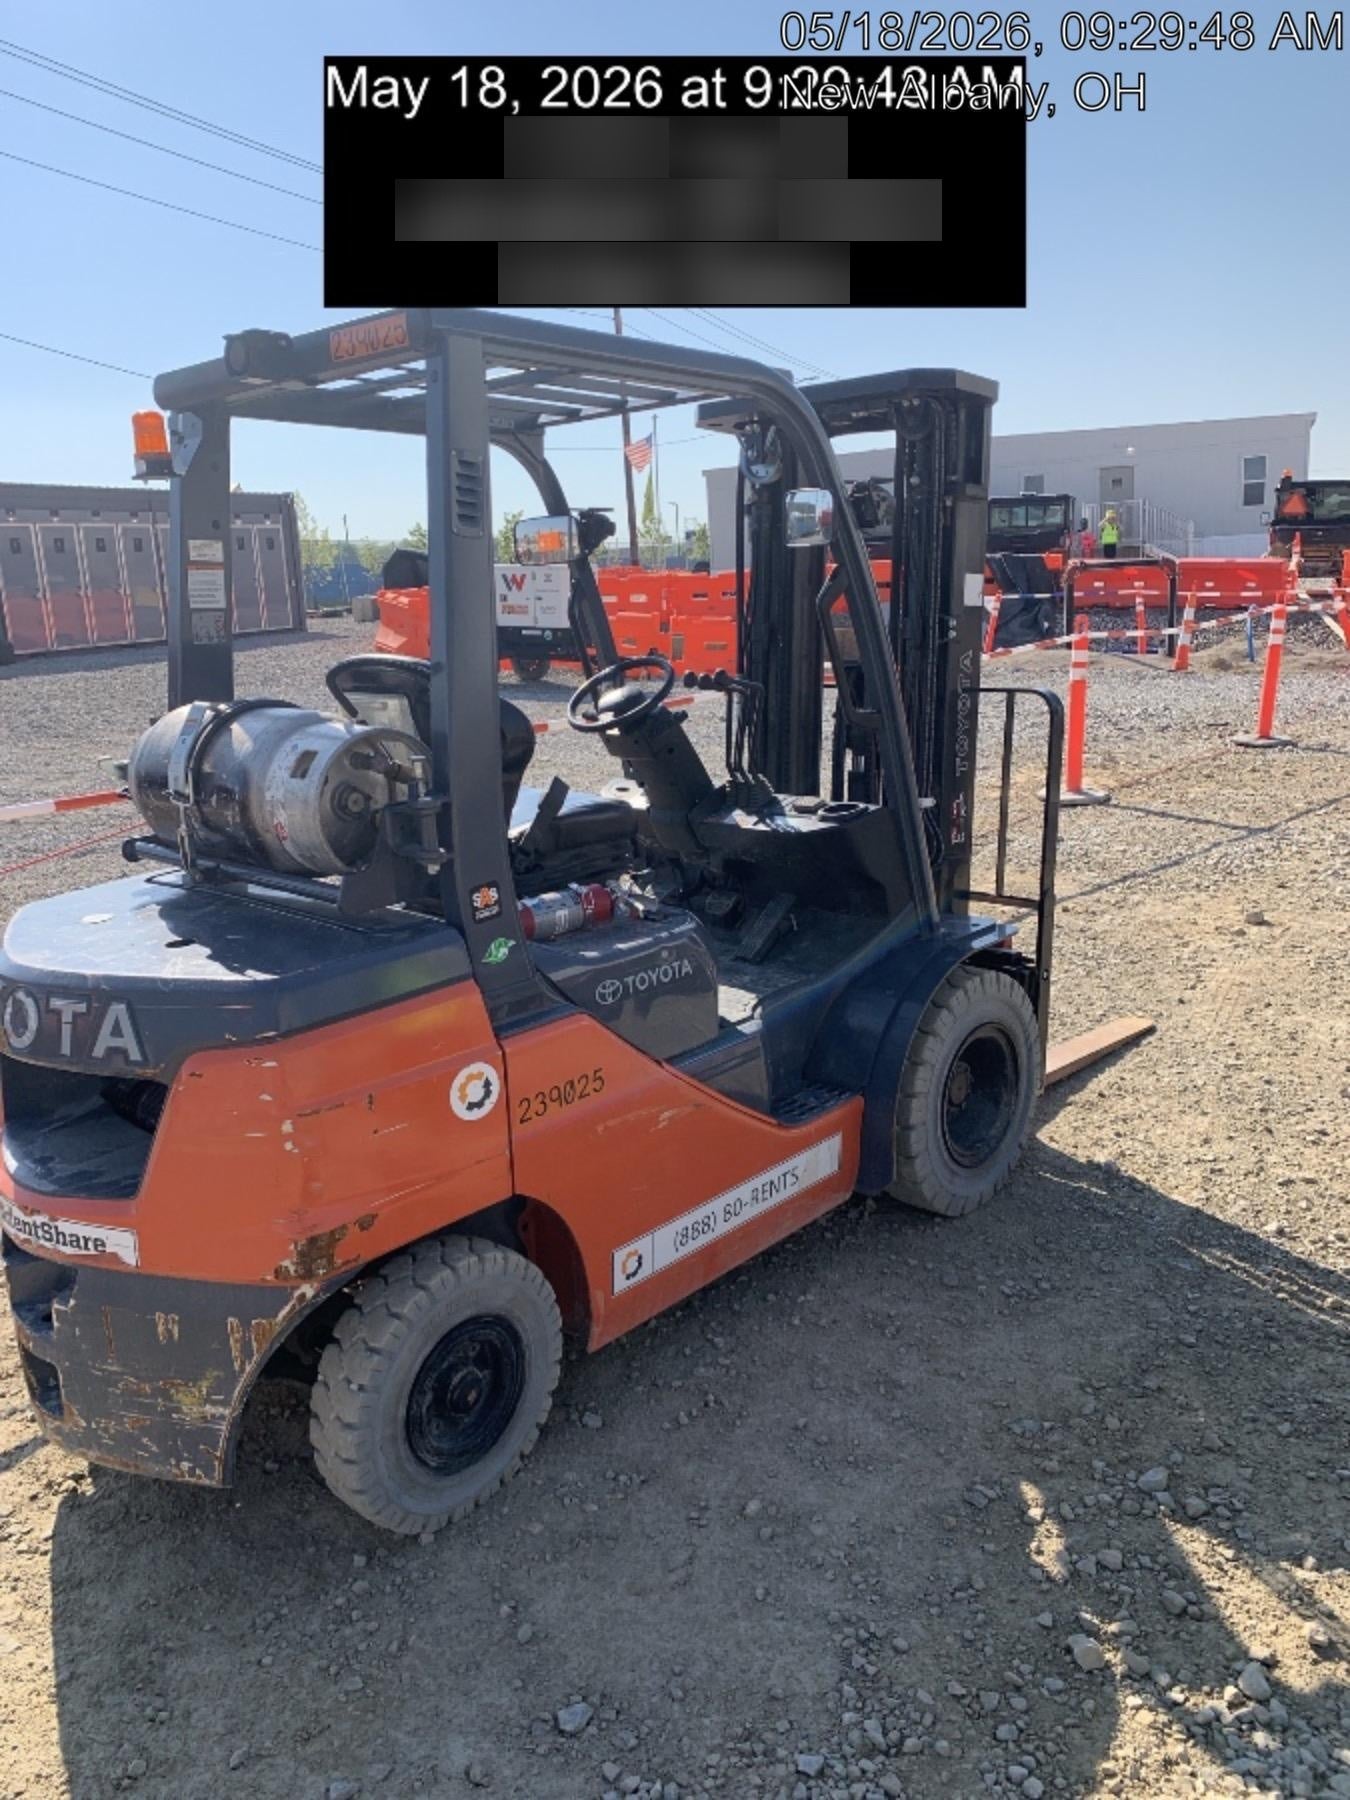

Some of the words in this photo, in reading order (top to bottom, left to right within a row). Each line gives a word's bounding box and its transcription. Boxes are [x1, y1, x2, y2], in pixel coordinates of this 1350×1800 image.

[955, 649, 974, 777] TOYOTA
[624, 959, 693, 995] TOYOTA
[518, 1067, 605, 1124] 239025
[673, 1211, 717, 1252] (888)
